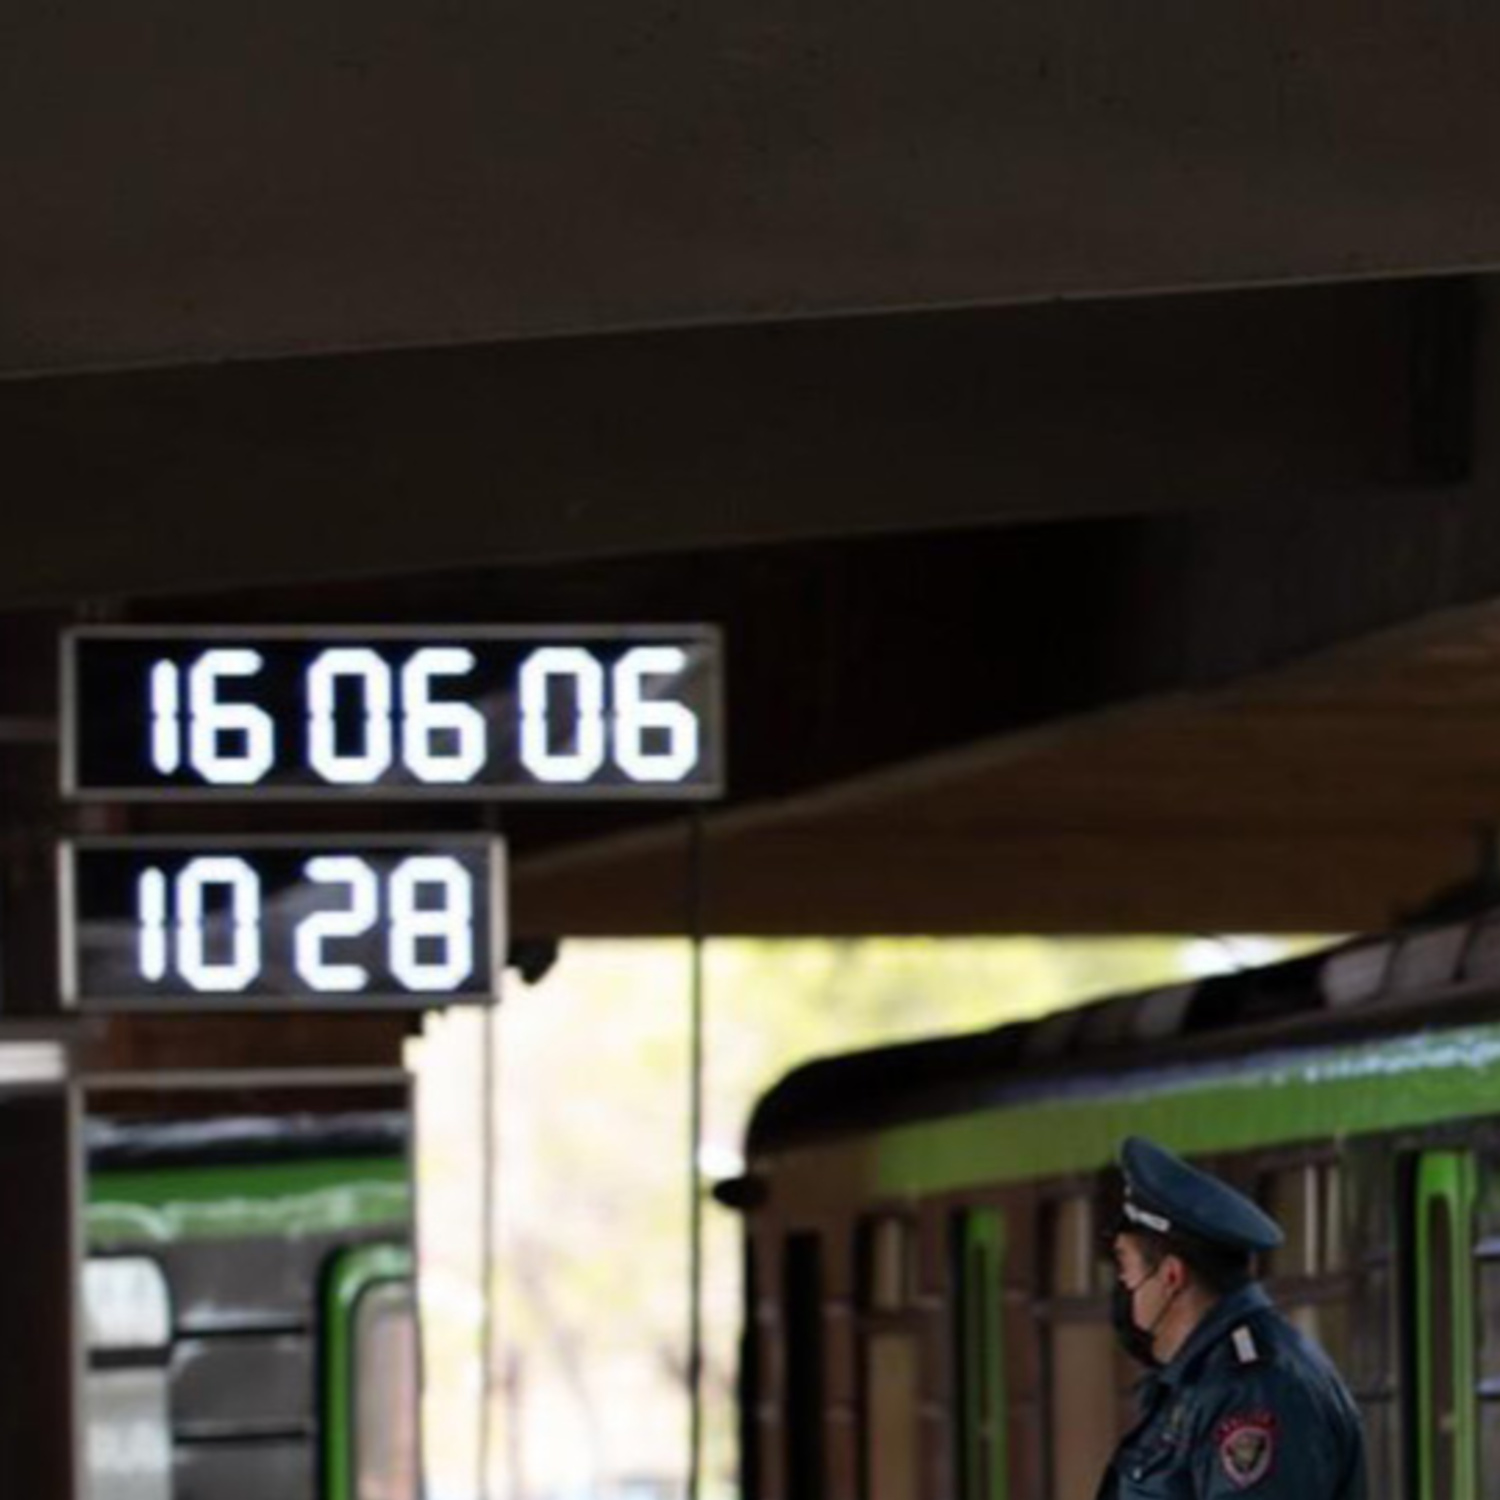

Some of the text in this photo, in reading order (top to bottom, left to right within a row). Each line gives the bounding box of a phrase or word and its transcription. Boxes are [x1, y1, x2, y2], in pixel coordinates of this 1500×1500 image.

[150, 646, 699, 784] 16 06 06
[138, 856, 473, 992] 10 28
